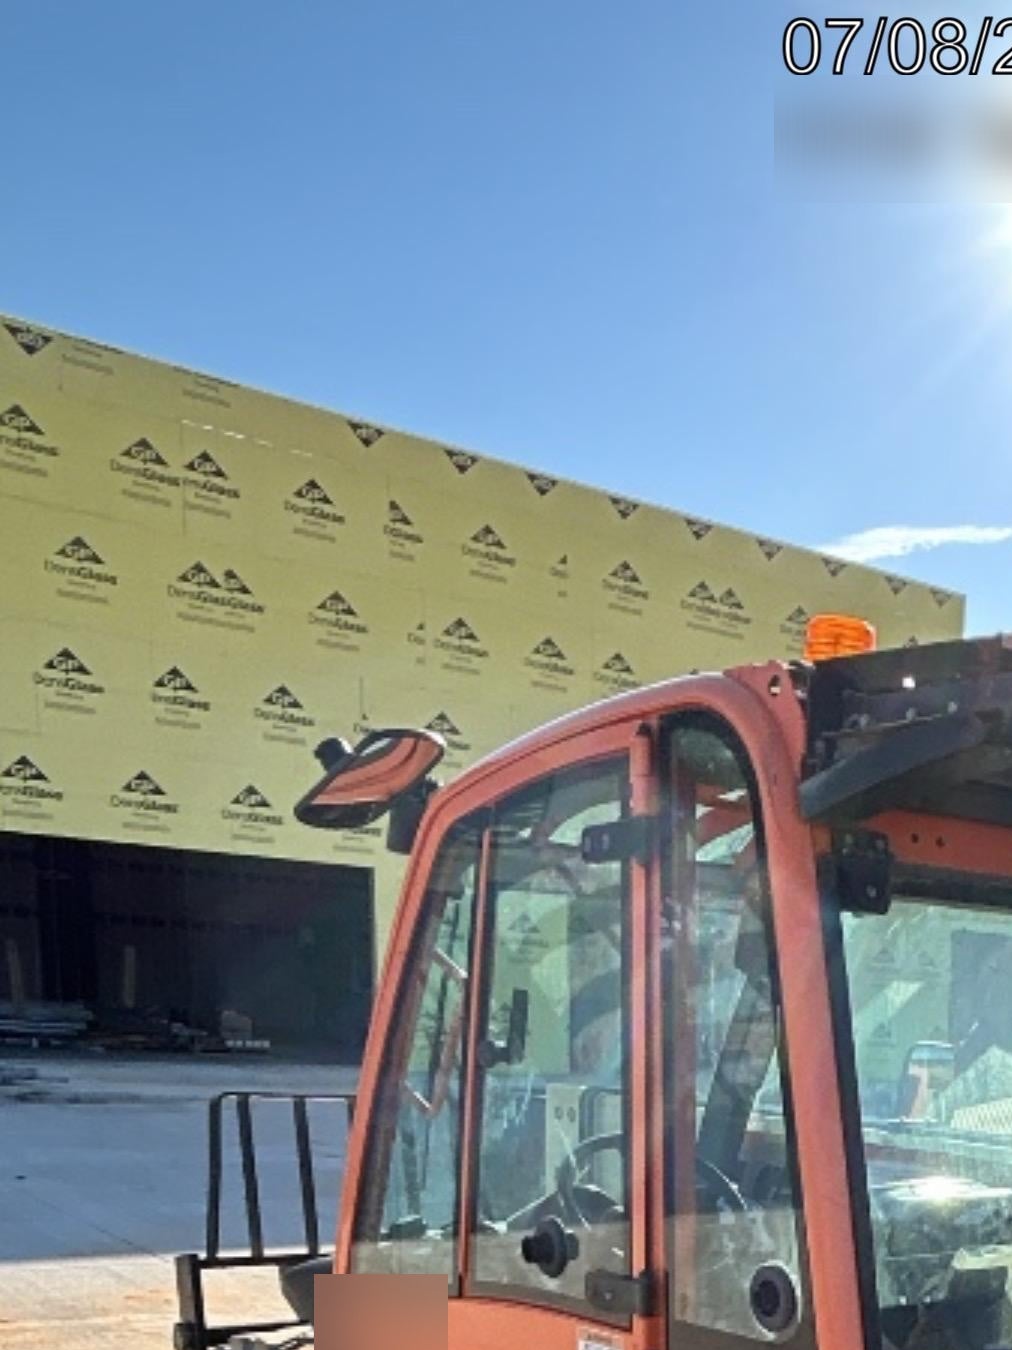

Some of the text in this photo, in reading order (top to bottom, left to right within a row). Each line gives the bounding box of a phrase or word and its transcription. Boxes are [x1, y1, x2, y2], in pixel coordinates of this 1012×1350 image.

[0, 434, 59, 456] nsGlass
[183, 477, 240, 498] ensGlass
[0, 784, 63, 801] ensGlass
